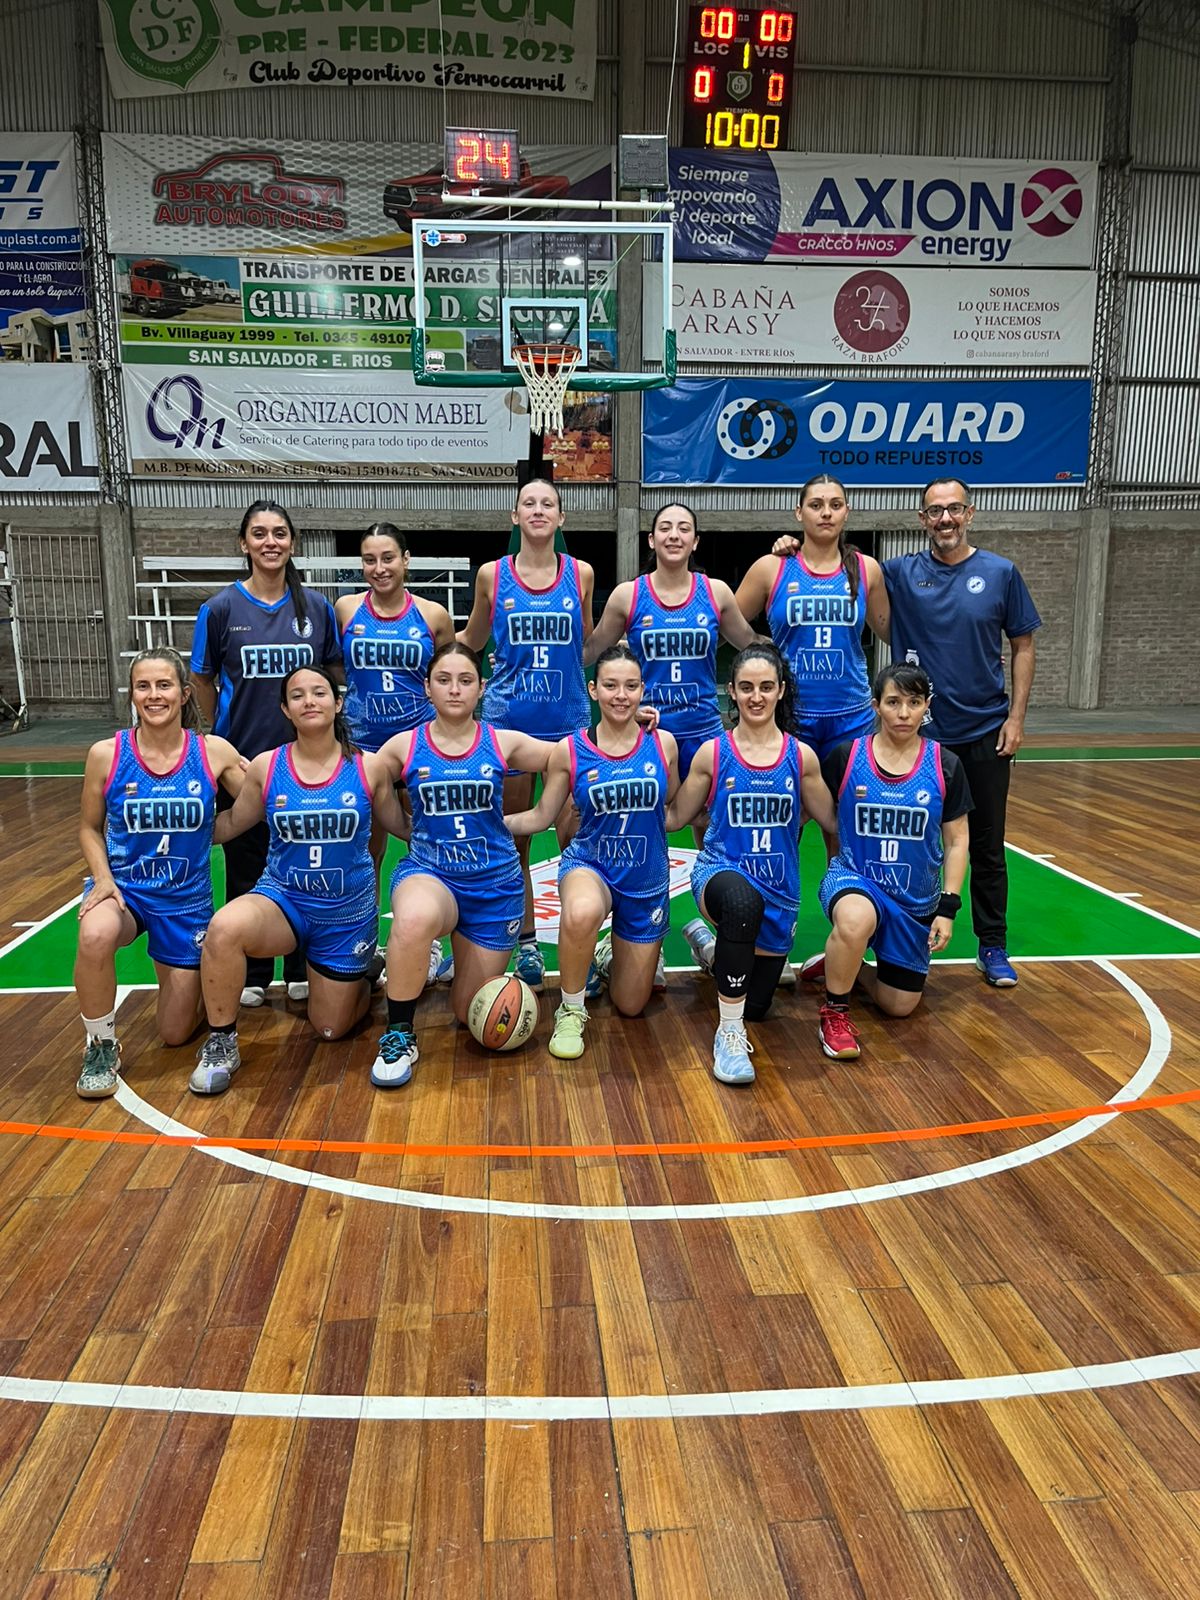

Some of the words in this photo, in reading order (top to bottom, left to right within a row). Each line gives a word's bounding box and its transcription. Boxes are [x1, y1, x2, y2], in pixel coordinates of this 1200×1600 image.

[700, 9, 734, 39] 00
[760, 13, 793, 42] 00
[237, 28, 307, 55] PRE
[338, 26, 495, 58] FEDERAL
[502, 36, 575, 64] 2023
[694, 41, 730, 56] LOC
[754, 45, 789, 59] VIS
[743, 42, 750, 69] 1
[250, 60, 300, 84] Club
[307, 58, 426, 86] Deportivo
[433, 62, 566, 92] Ferrocarril
[694, 69, 711, 98] 0
[767, 73, 784, 101] 0
[705, 111, 780, 149] 10:00
[457, 138, 511, 180] 24
[678, 165, 749, 183] Siempre
[167, 181, 338, 207] BRYLODY
[670, 188, 757, 205] apoyando
[801, 177, 1015, 232] AXION
[156, 205, 346, 231] AUTOMOTORES
[669, 209, 684, 223] el
[690, 210, 756, 226] deporte
[692, 230, 734, 246] local
[798, 238, 853, 251] CRACCO
[855, 238, 898, 252] HNOS.
[921, 235, 1013, 262] energy
[6, 261, 25, 271] PARA
[26, 261, 35, 271] LA
[243, 261, 375, 282] TRANSPORTE
[380, 266, 406, 282] DE
[496, 267, 608, 285] GENERALES
[12, 288, 25, 296] un
[26, 285, 46, 296] solo
[989, 287, 1031, 297] SOMOS
[249, 288, 431, 321] GUILLERMO
[440, 295, 468, 322] D.
[958, 301, 974, 312] LO
[976, 301, 1001, 314] QUE
[1003, 301, 1060, 312] HACEMOS
[681, 313, 781, 336] ARASY
[974, 316, 983, 326] Y
[985, 316, 1042, 326] HACEMOS
[141, 326, 163, 339] Bv.
[167, 327, 235, 343] Villaguay
[239, 329, 275, 341] 1999
[294, 331, 319, 343] Tel.
[323, 331, 358, 344] 0345
[370, 333, 431, 345] 491079
[953, 330, 969, 340] LO
[970, 330, 996, 342] QUE
[998, 330, 1021, 341] NOS
[1023, 330, 1061, 341] GUSTA
[188, 350, 224, 364] SAN
[228, 351, 318, 367] SALVADOR
[332, 353, 347, 368] E.
[352, 354, 393, 368] RIOS
[684, 347, 733, 356] SALVADOR
[740, 348, 771, 357] ENTRE
[773, 346, 796, 357] RÍOS
[831, 335, 857, 361] RAZA
[861, 336, 911, 363] BRAFORD
[237, 399, 408, 425] ORGANIZACION
[415, 402, 488, 426] MABEL
[808, 401, 1025, 443] ODIARD
[239, 433, 283, 446] Servicio
[285, 434, 300, 446] de
[303, 434, 349, 449] Catering
[352, 438, 375, 449] para
[378, 436, 404, 447] todo
[407, 436, 429, 450] tipo
[431, 436, 445, 448] de
[447, 437, 489, 448] eventos
[819, 449, 870, 465] TODO
[875, 450, 983, 466] REPUESTOS
[143, 462, 172, 473] M.B.
[175, 462, 192, 473] DE
[314, 465, 351, 477] (0345)
[431, 466, 456, 478] SAN
[790, 598, 856, 624] FERRO
[510, 614, 570, 643] FERRO
[814, 626, 832, 648] 13
[352, 641, 420, 668] FERRO
[643, 631, 708, 659] FERRO
[243, 646, 312, 677] FERRO
[532, 646, 549, 669] 15
[670, 662, 682, 683] 6
[421, 783, 492, 813] FERRO
[592, 781, 657, 813] FERRO
[126, 801, 201, 833] FERRO
[730, 796, 792, 824] FERRO
[858, 806, 926, 837] FERRO
[275, 811, 357, 841] FERRO
[453, 815, 467, 839] 5
[619, 813, 630, 835] 7
[156, 834, 170, 856] 4
[751, 829, 772, 853] 14
[880, 839, 899, 862] 10
[309, 845, 322, 868] 9
